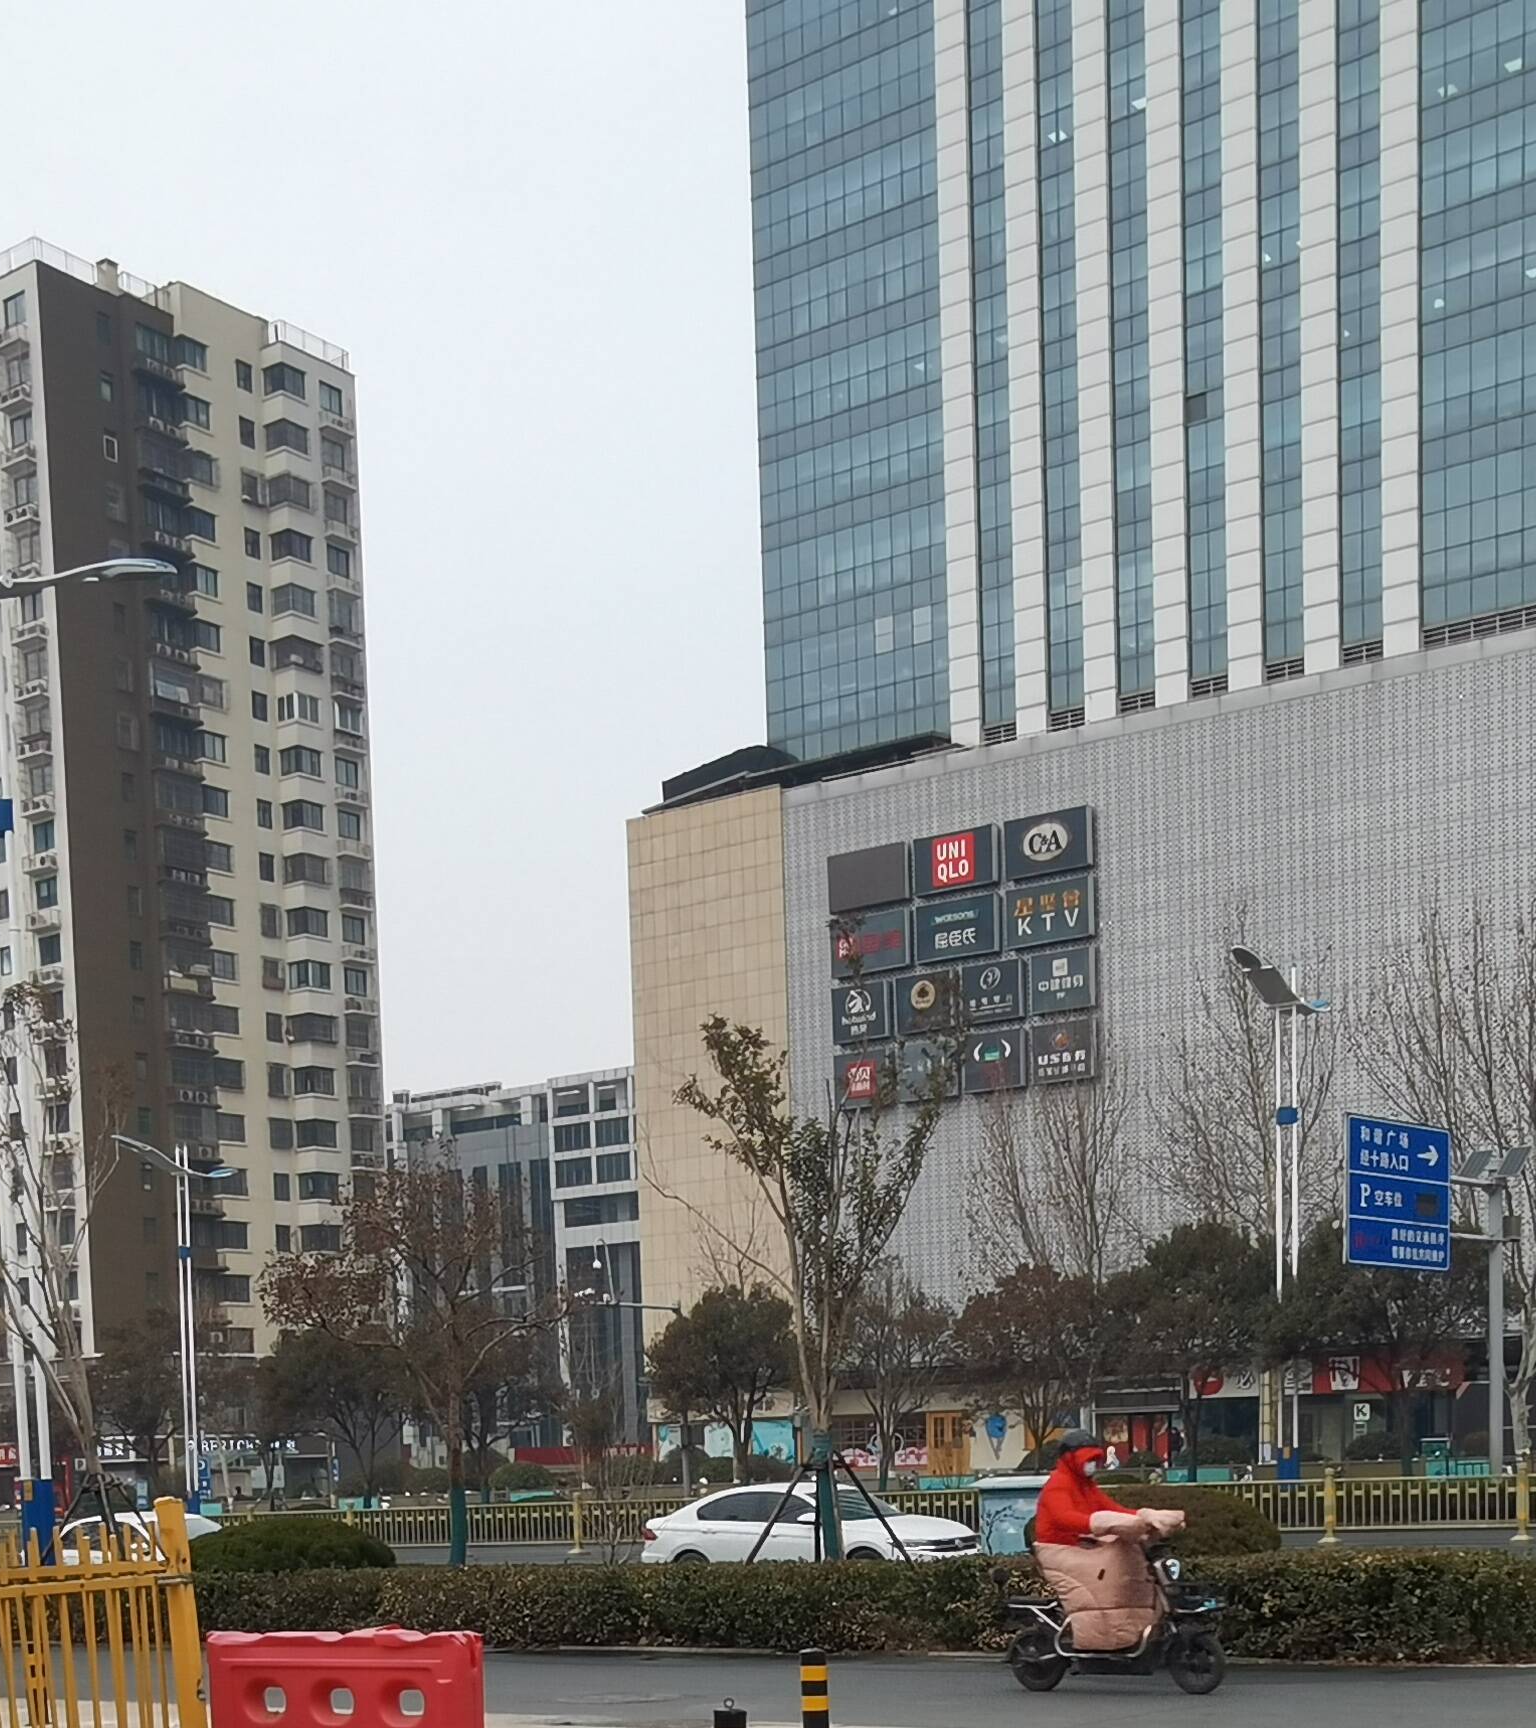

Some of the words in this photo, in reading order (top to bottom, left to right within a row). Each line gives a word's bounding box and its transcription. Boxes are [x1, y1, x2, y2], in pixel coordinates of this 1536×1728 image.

[936, 839, 966, 862] UNI
[1028, 829, 1063, 855] C&A
[937, 859, 970, 883] QLO
[1018, 908, 1079, 937] KTV
[1359, 1183, 1372, 1208] P
[1374, 1190, 1403, 1208] 空车位
